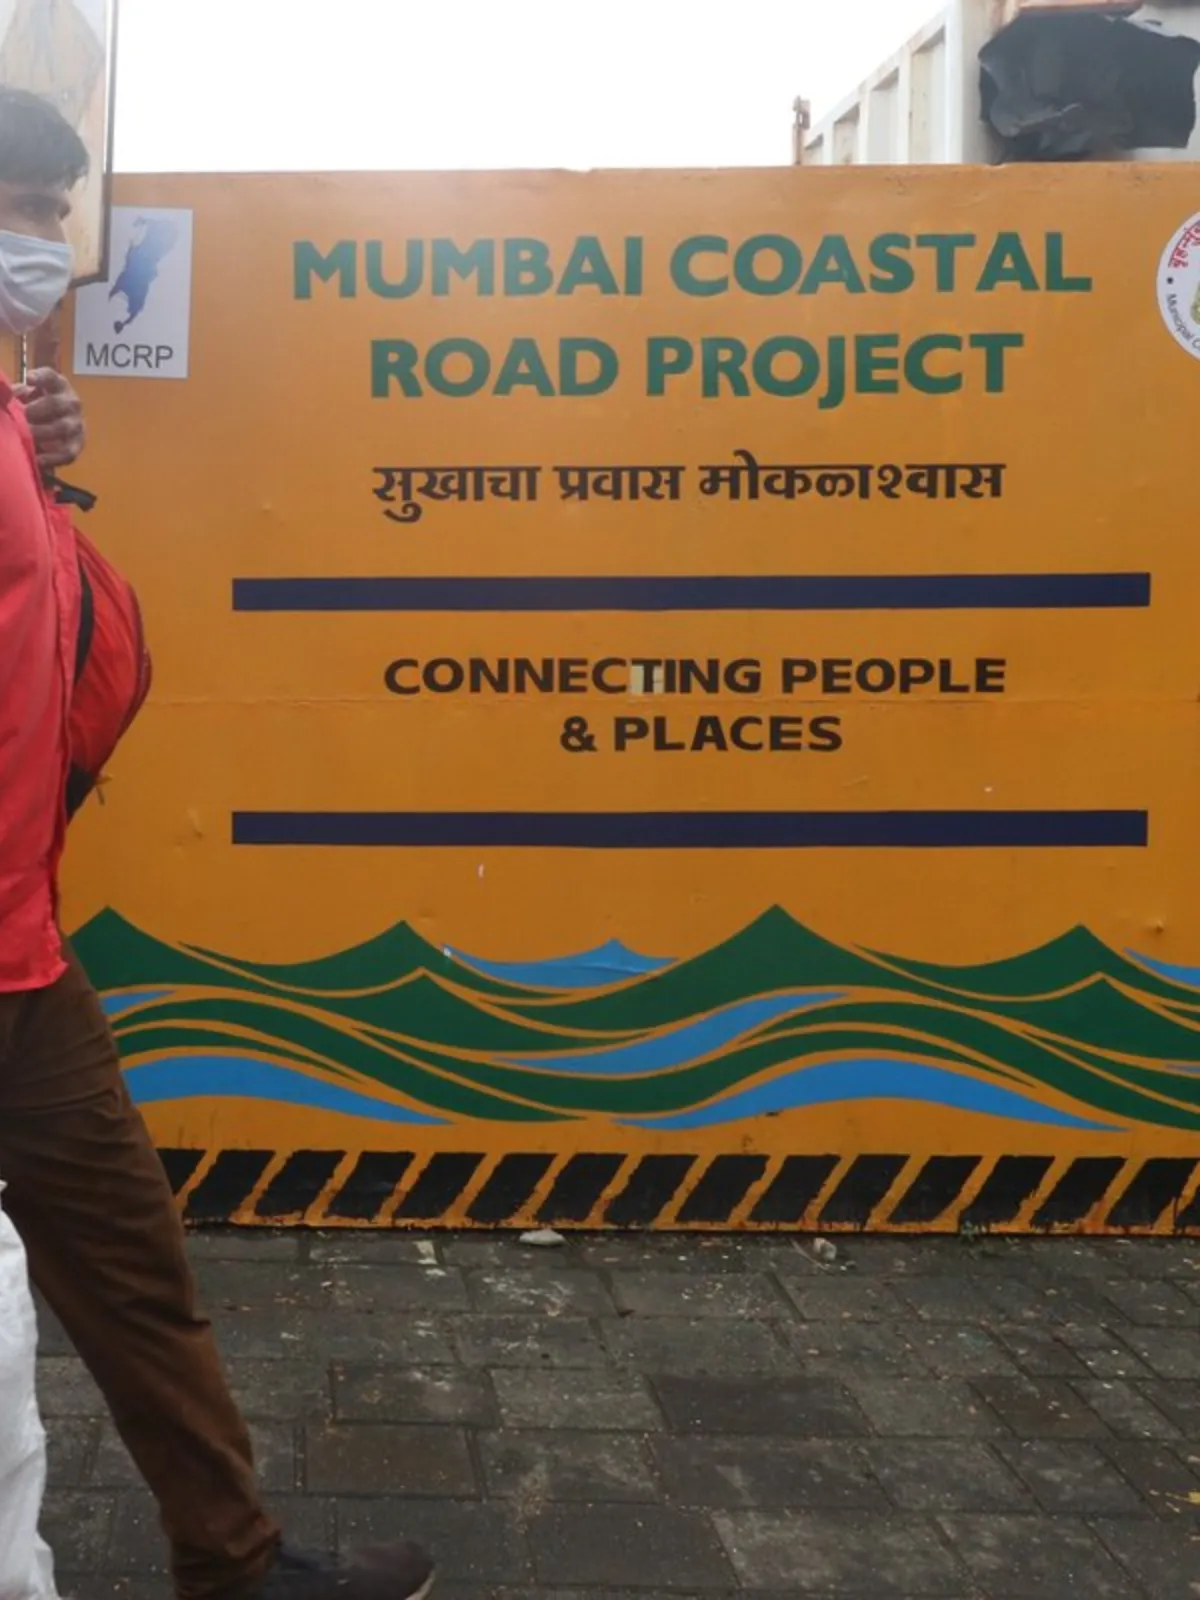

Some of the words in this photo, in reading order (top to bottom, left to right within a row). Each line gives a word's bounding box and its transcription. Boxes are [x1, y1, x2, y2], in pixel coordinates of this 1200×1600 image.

[293, 237, 644, 299] MUMBAI
[669, 231, 1093, 296] COASTAL
[85, 342, 174, 370] MCRP
[371, 337, 620, 398] ROAD
[646, 332, 1023, 409] PROJECT
[372, 465, 542, 523] सुखाचा
[553, 465, 685, 501] प्रवास
[383, 657, 762, 695] CONNECTING
[781, 658, 1007, 694] PEOPLE
[559, 715, 597, 753] &
[613, 715, 843, 753] PLACES
